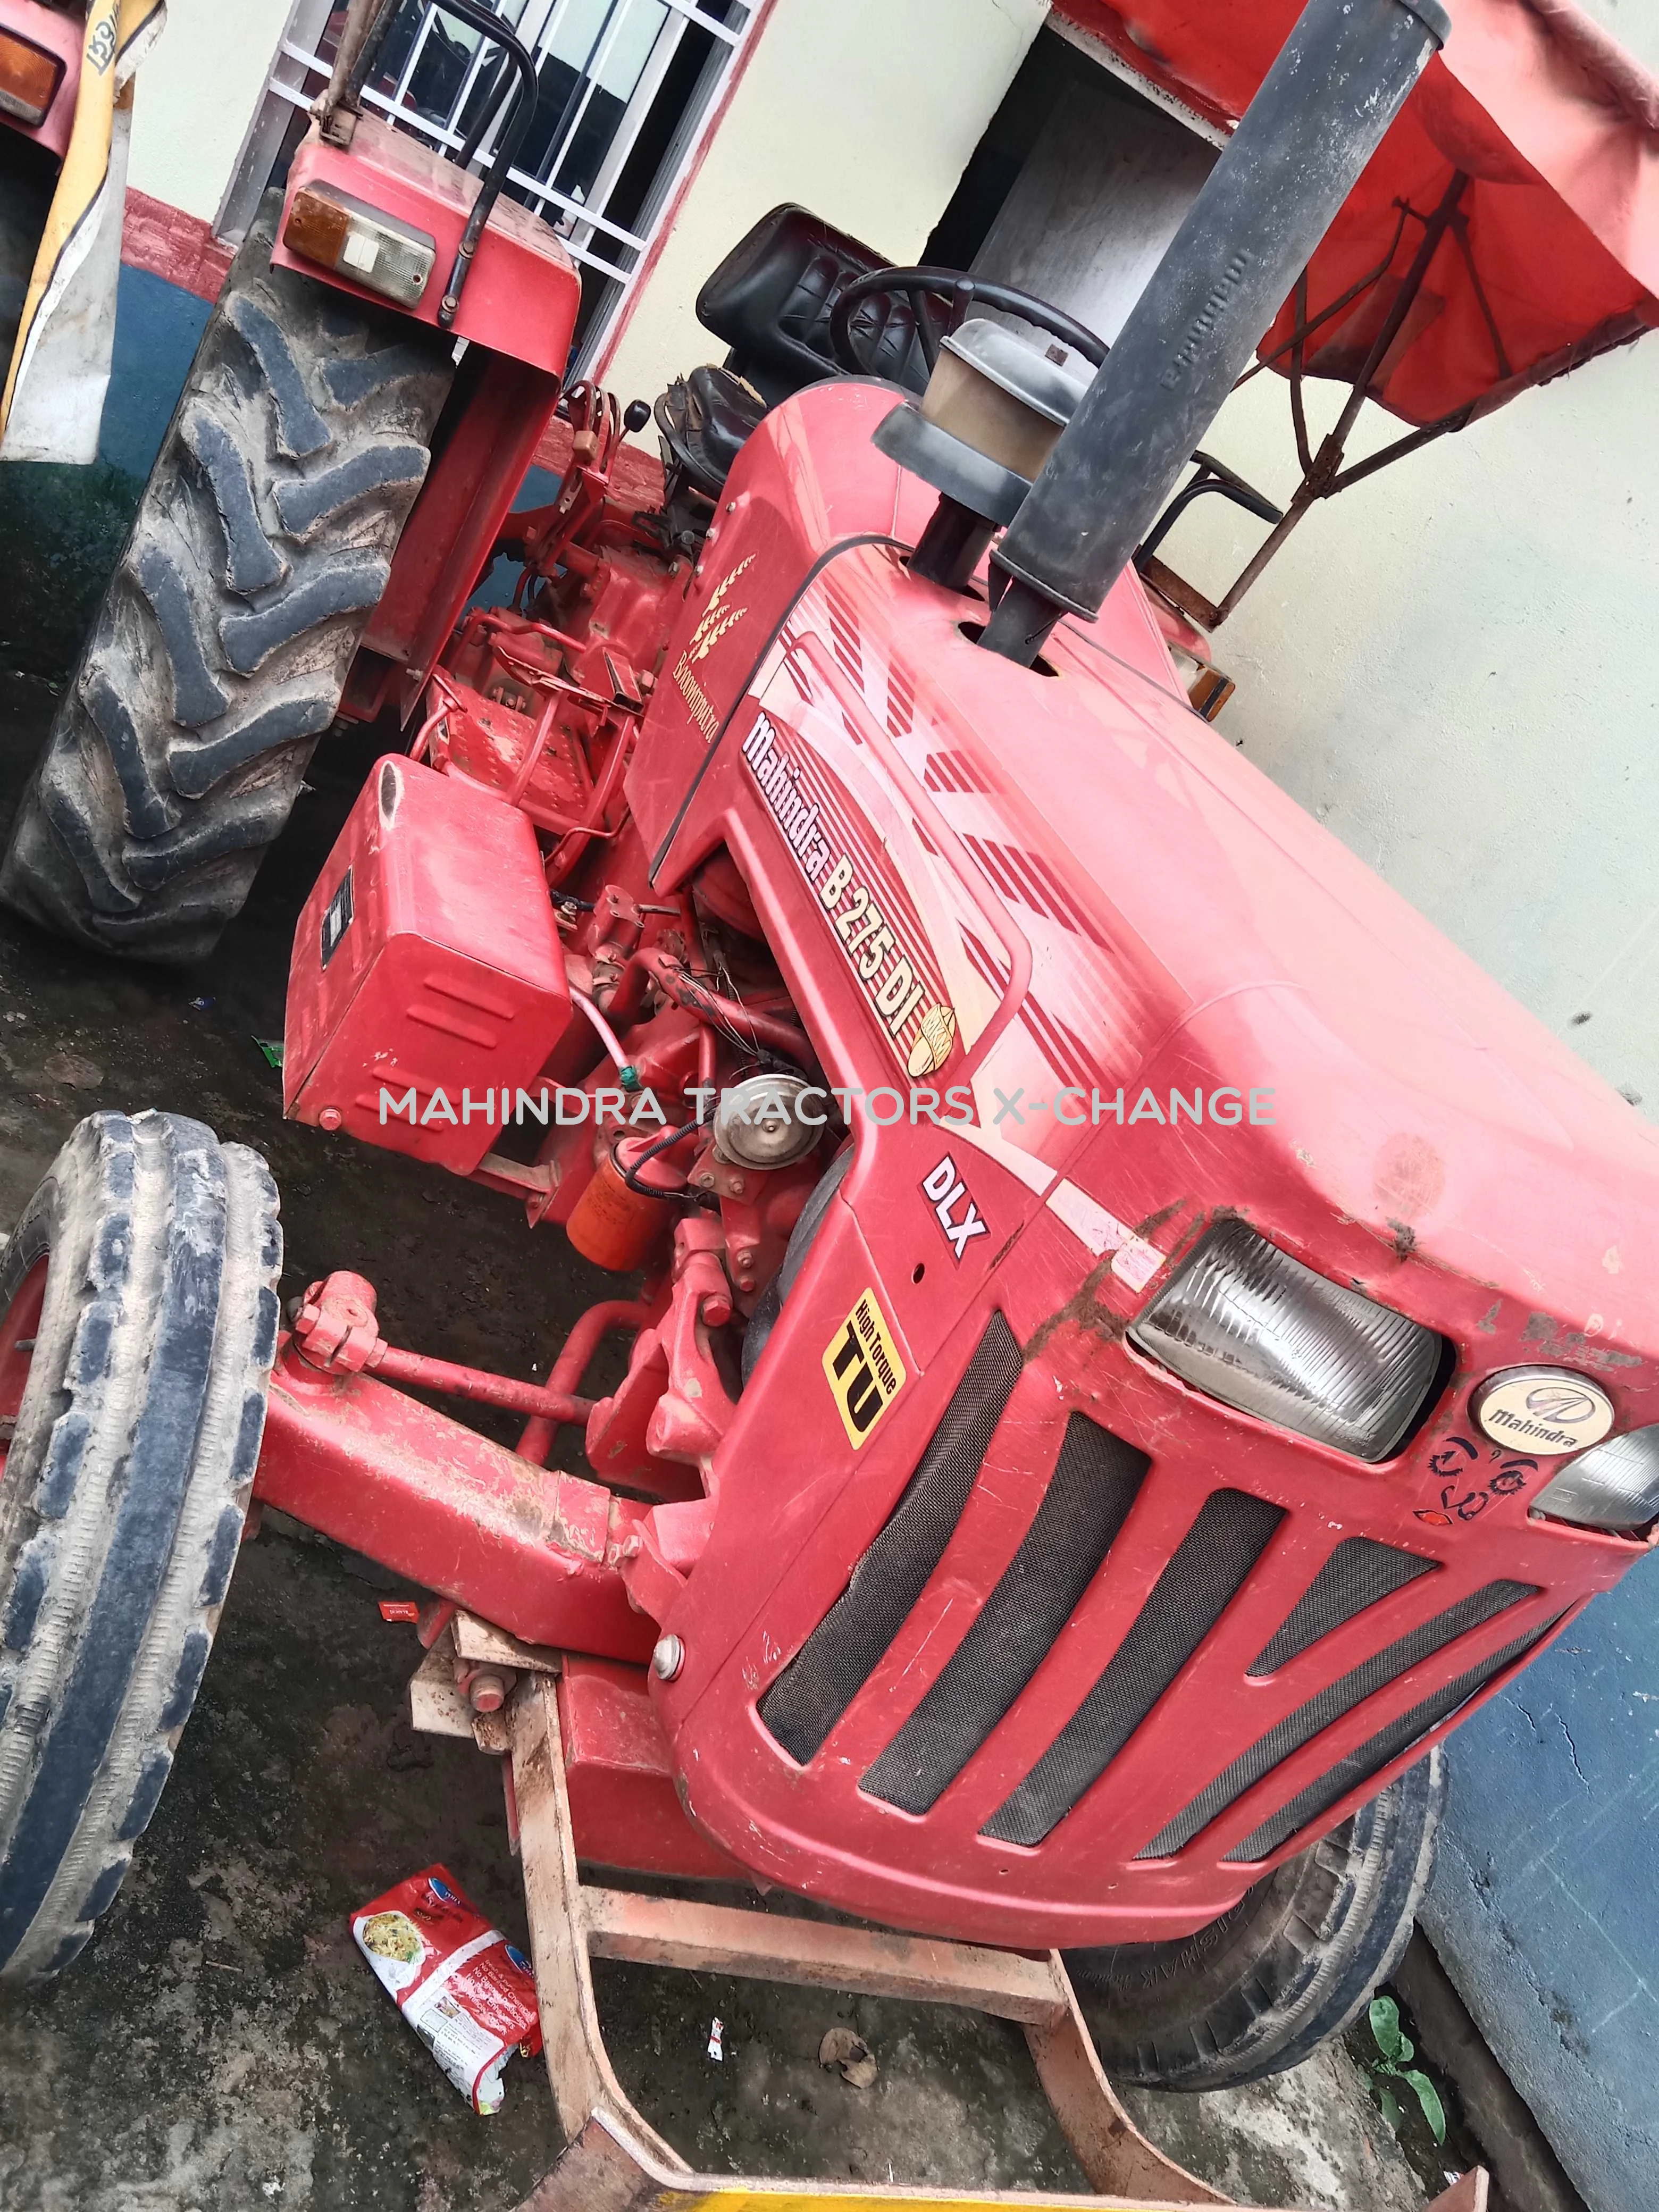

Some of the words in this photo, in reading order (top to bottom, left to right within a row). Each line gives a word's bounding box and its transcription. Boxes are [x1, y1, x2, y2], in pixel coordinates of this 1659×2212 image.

[819, 853, 853, 911] B
[834, 885, 896, 981] 275
[875, 954, 925, 1038] DI
[923, 1155, 987, 1260] DLX
[832, 1320, 883, 1432] TU
[855, 1299, 875, 1343] High
[869, 1331, 896, 1395] Torque
[473, 1967, 482, 1977] No
[1141, 1885, 1253, 1988] RISHAK
